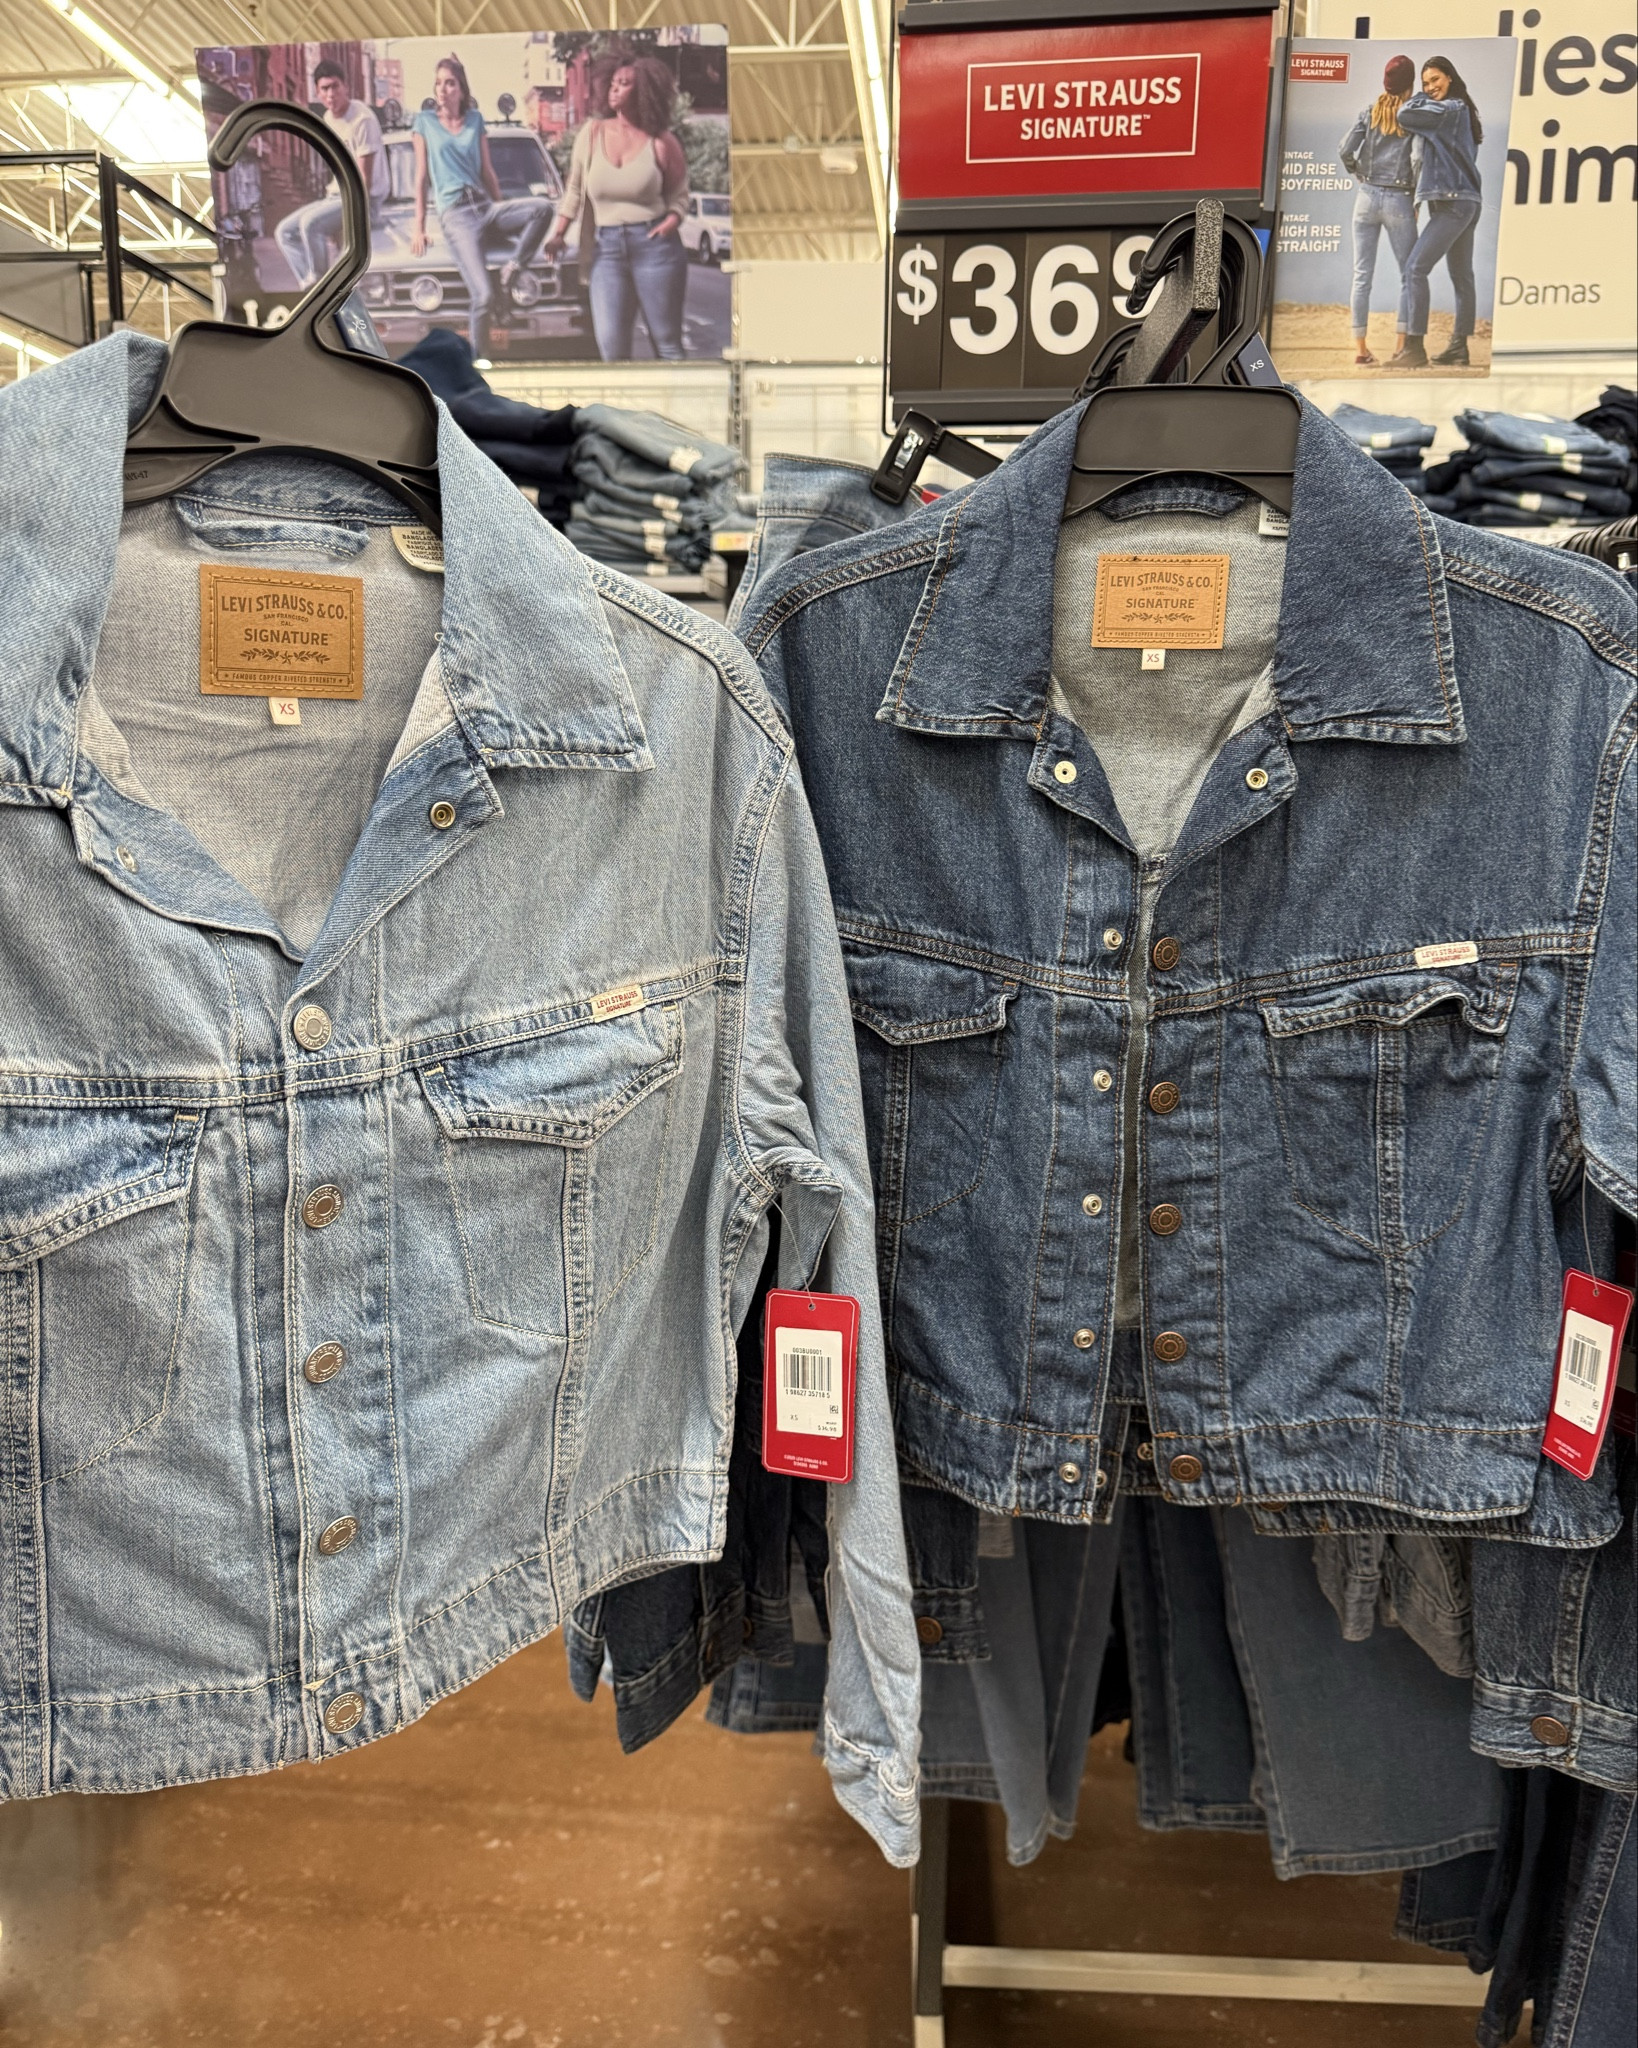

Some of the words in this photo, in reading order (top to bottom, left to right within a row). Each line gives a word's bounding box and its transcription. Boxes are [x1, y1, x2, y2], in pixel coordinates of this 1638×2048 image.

[1291, 58, 1309, 67] LEVI
[1310, 59, 1345, 69] STRAUSS
[983, 82, 1046, 112] LEVI
[1053, 76, 1182, 109] STRAUSS
[1283, 151, 1314, 160] INTAGE
[1306, 163, 1337, 175] RISE
[1281, 178, 1353, 191] BOYFRIEND
[1282, 214, 1310, 222] NTAGE
[1310, 225, 1341, 237] RISE
[1276, 240, 1340, 253] STRAIGHT
[1500, 277, 1602, 305] Damas
[352, 319, 367, 331] XS
[1250, 359, 1265, 372] XS
[1110, 576, 1134, 589] LEVI
[1137, 572, 1185, 586] STRAUSS
[1196, 577, 1213, 588] CO.
[221, 595, 252, 613] LEVI
[256, 593, 315, 617] STRAUSS
[317, 603, 327, 618] &
[328, 604, 348, 620] CO.
[276, 613, 309, 623] FRANCISCO
[1147, 653, 1160, 663] XS
[232, 672, 256, 681] FAMOUS
[279, 703, 295, 715] XS
[596, 998, 611, 1009] LEVI
[611, 991, 638, 1004] STRAUSS
